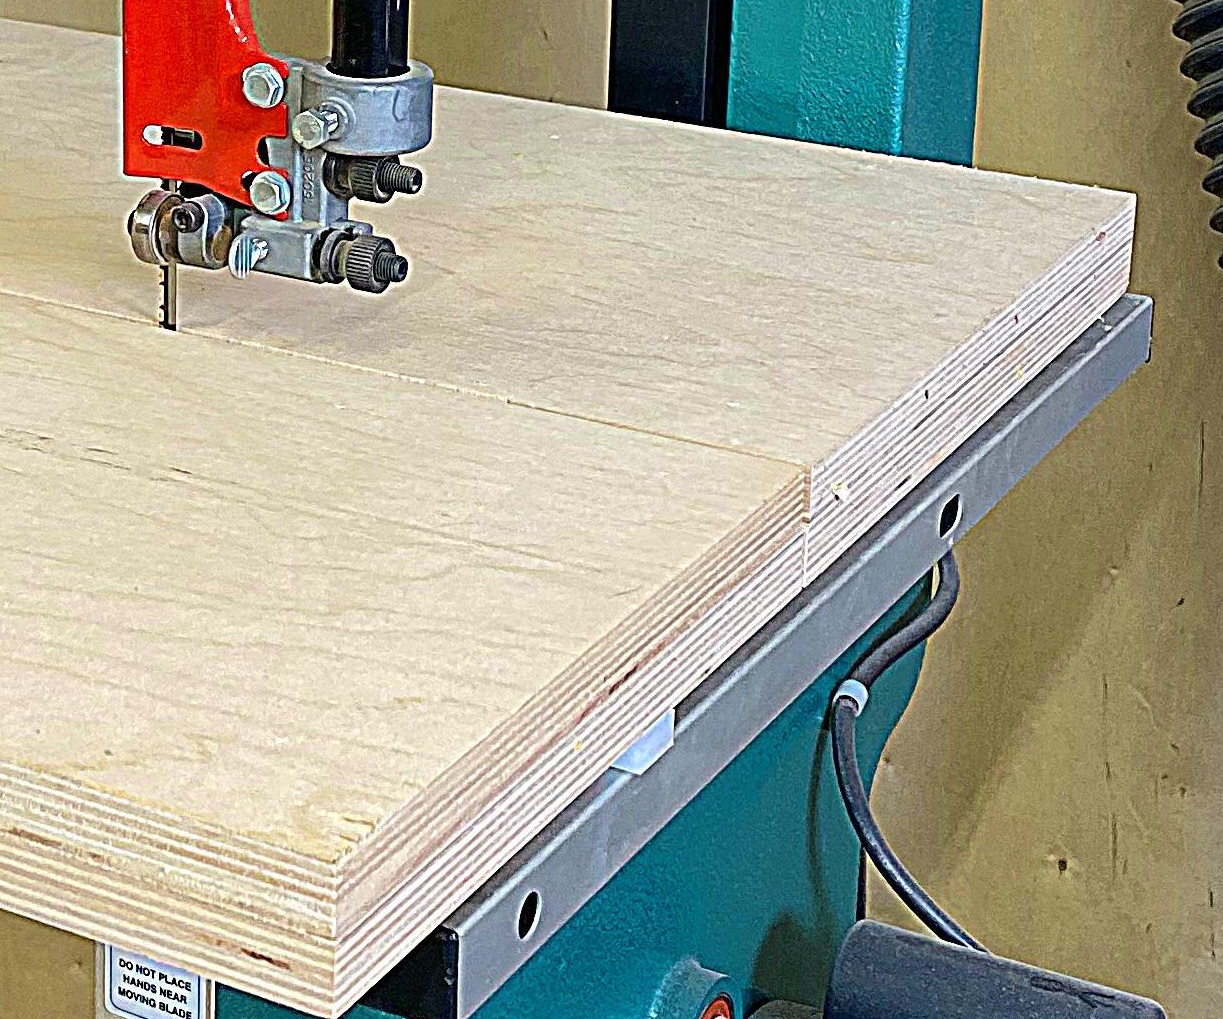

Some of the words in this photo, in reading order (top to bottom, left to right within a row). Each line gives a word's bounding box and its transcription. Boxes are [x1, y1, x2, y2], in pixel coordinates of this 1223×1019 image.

[119, 958, 134, 971] DO
[136, 964, 156, 979] NOT
[159, 972, 192, 992] PLACE
[122, 973, 157, 994] HANDS
[159, 986, 188, 1005] NEAR
[118, 986, 157, 1008] MOVING
[159, 1001, 192, 1019] BLADE
